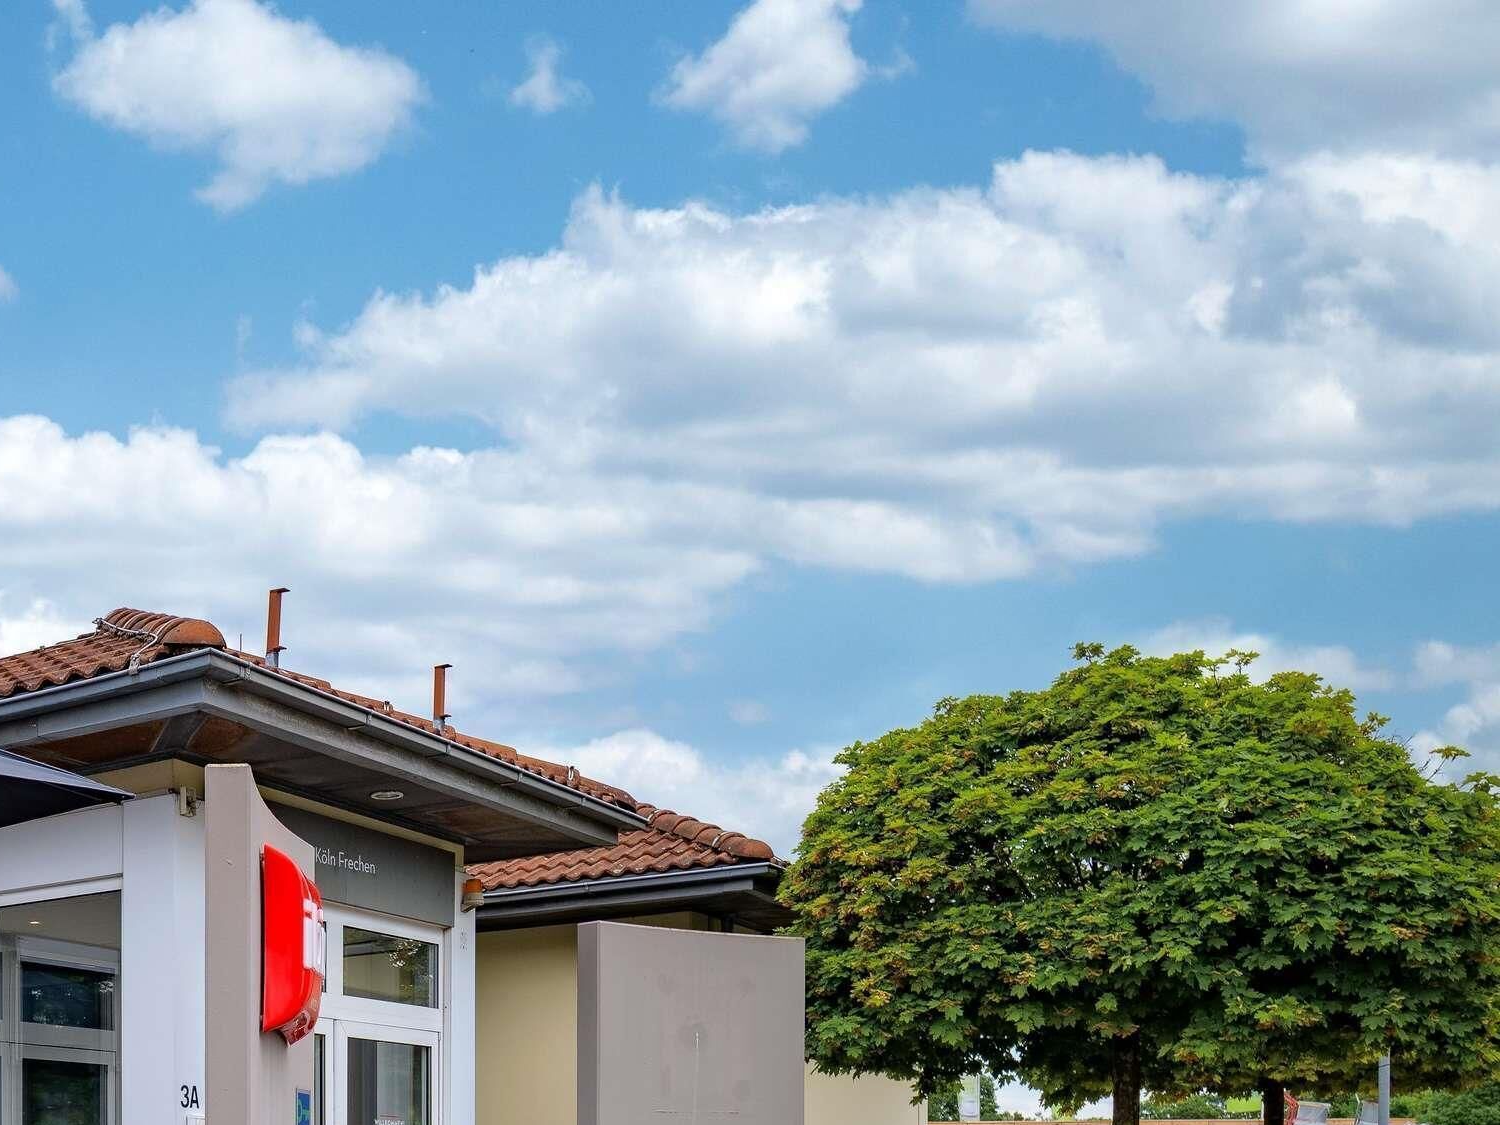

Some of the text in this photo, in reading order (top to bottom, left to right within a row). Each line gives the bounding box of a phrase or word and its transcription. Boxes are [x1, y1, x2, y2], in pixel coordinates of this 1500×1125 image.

[315, 846, 376, 875] Köln Frechen
[180, 1085, 199, 1109] 3A
